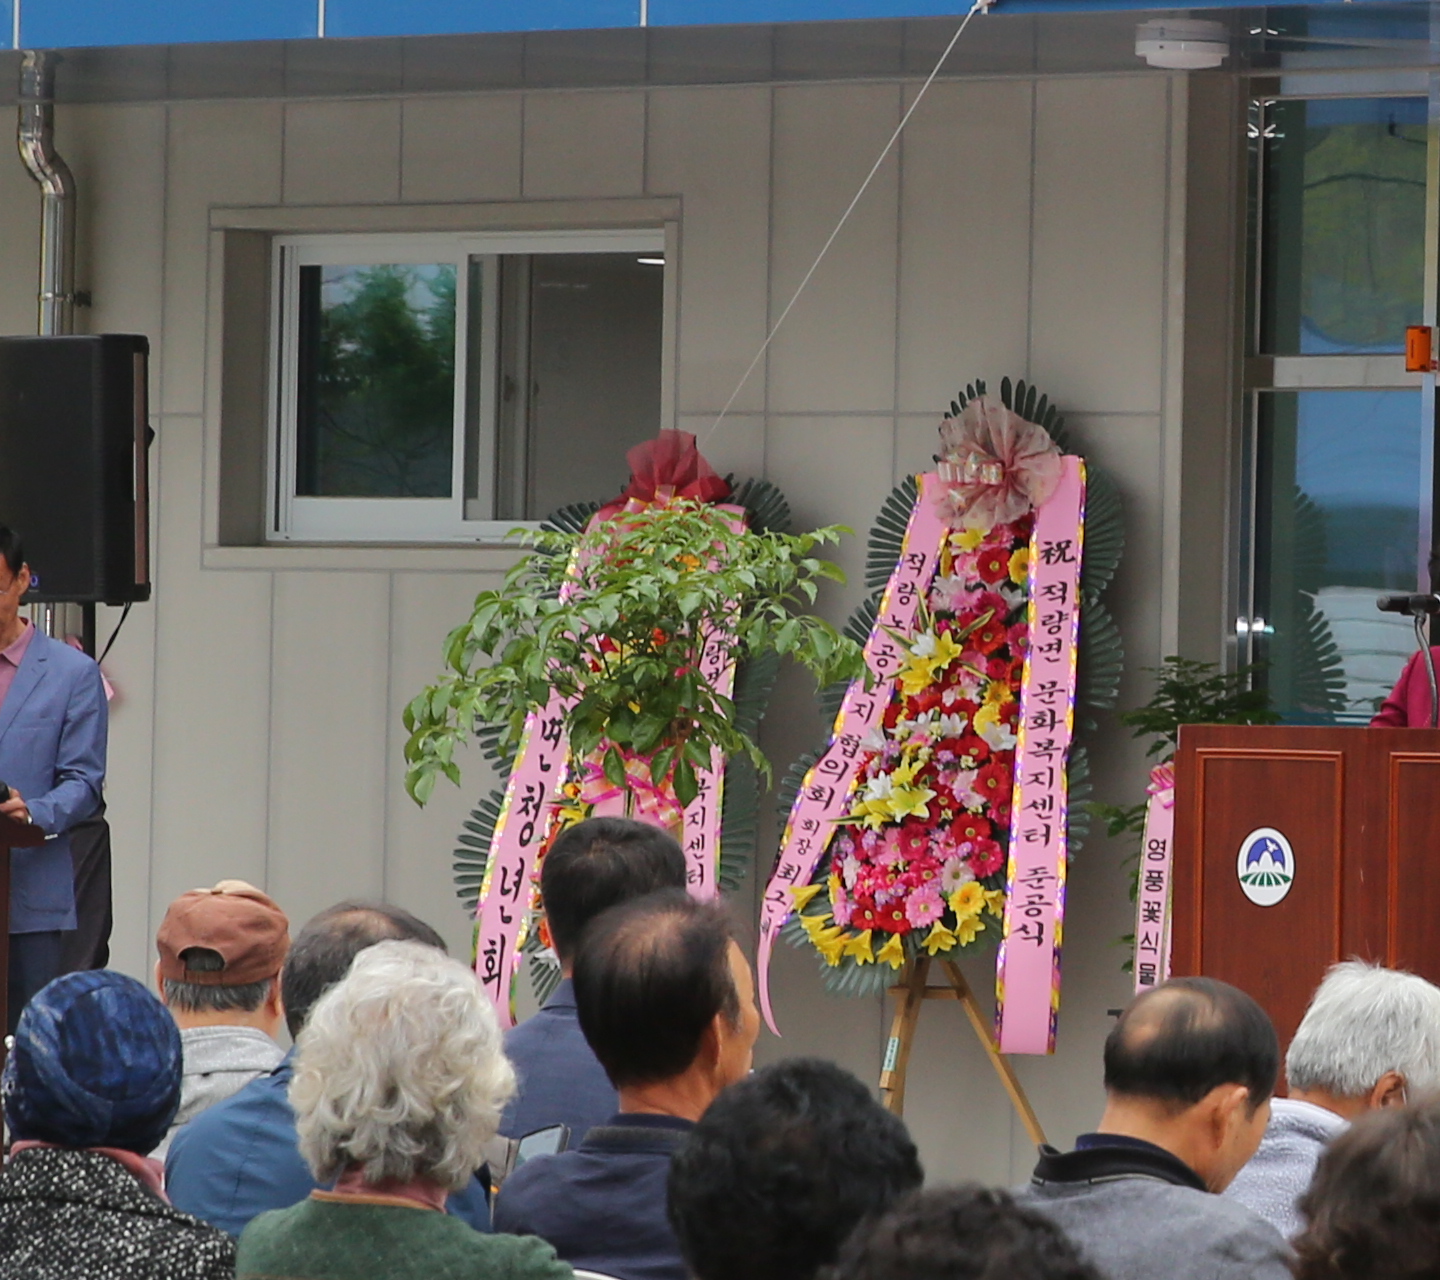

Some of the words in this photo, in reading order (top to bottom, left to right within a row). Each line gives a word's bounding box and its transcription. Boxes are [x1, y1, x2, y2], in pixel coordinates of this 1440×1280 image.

[1040, 539, 1076, 567] 祝
[1036, 581, 1072, 663] 적량면
[1023, 681, 1067, 848] 문화복지센터
[793, 818, 821, 857] 회장
[1013, 866, 1055, 947] 준공식
